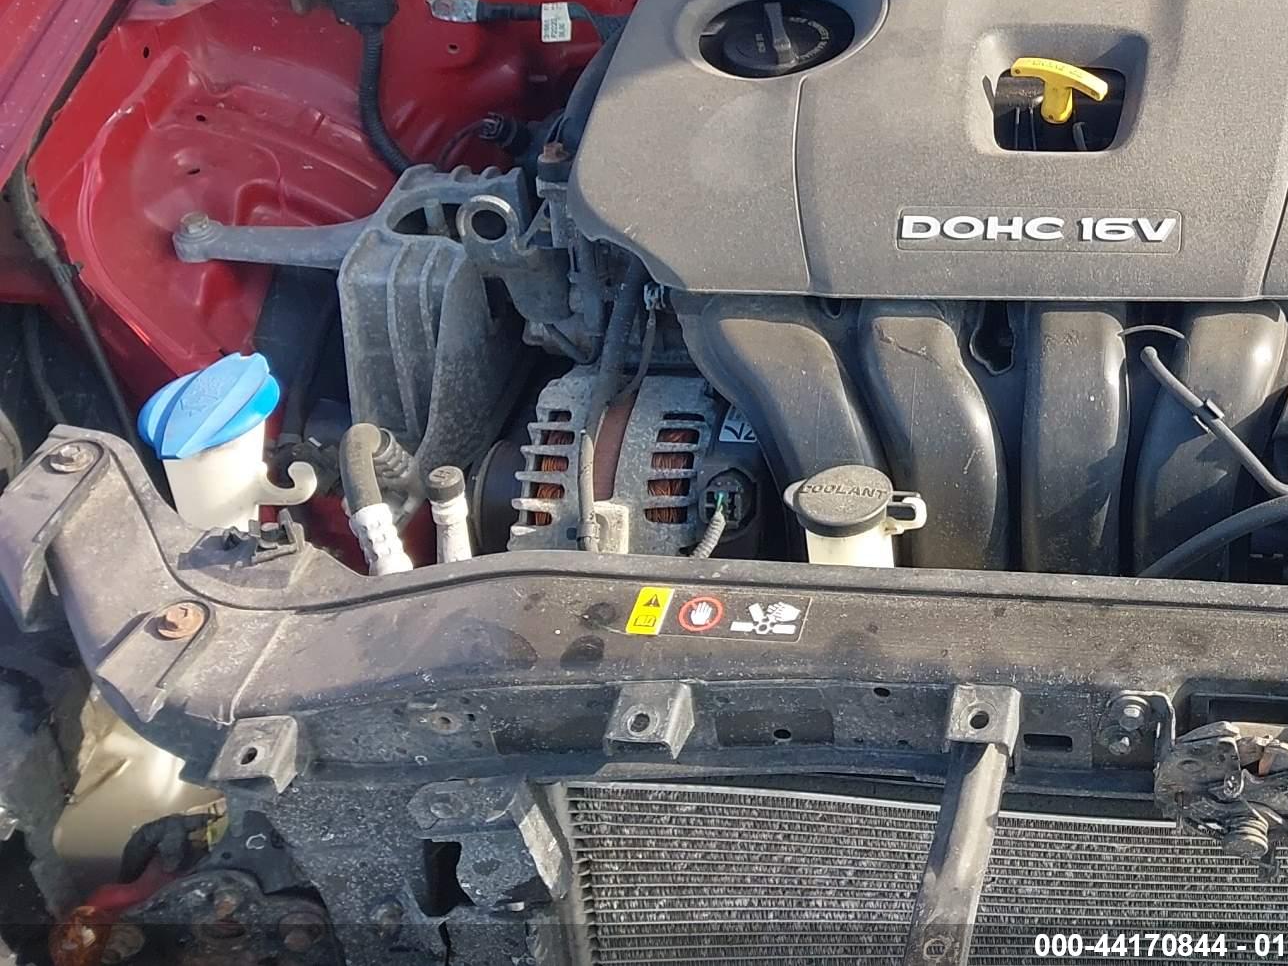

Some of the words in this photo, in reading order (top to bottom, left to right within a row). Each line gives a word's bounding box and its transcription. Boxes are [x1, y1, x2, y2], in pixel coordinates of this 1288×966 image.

[899, 215, 1065, 241] DOHC
[1077, 217, 1177, 243] 16V
[799, 484, 888, 500] COOLANT
